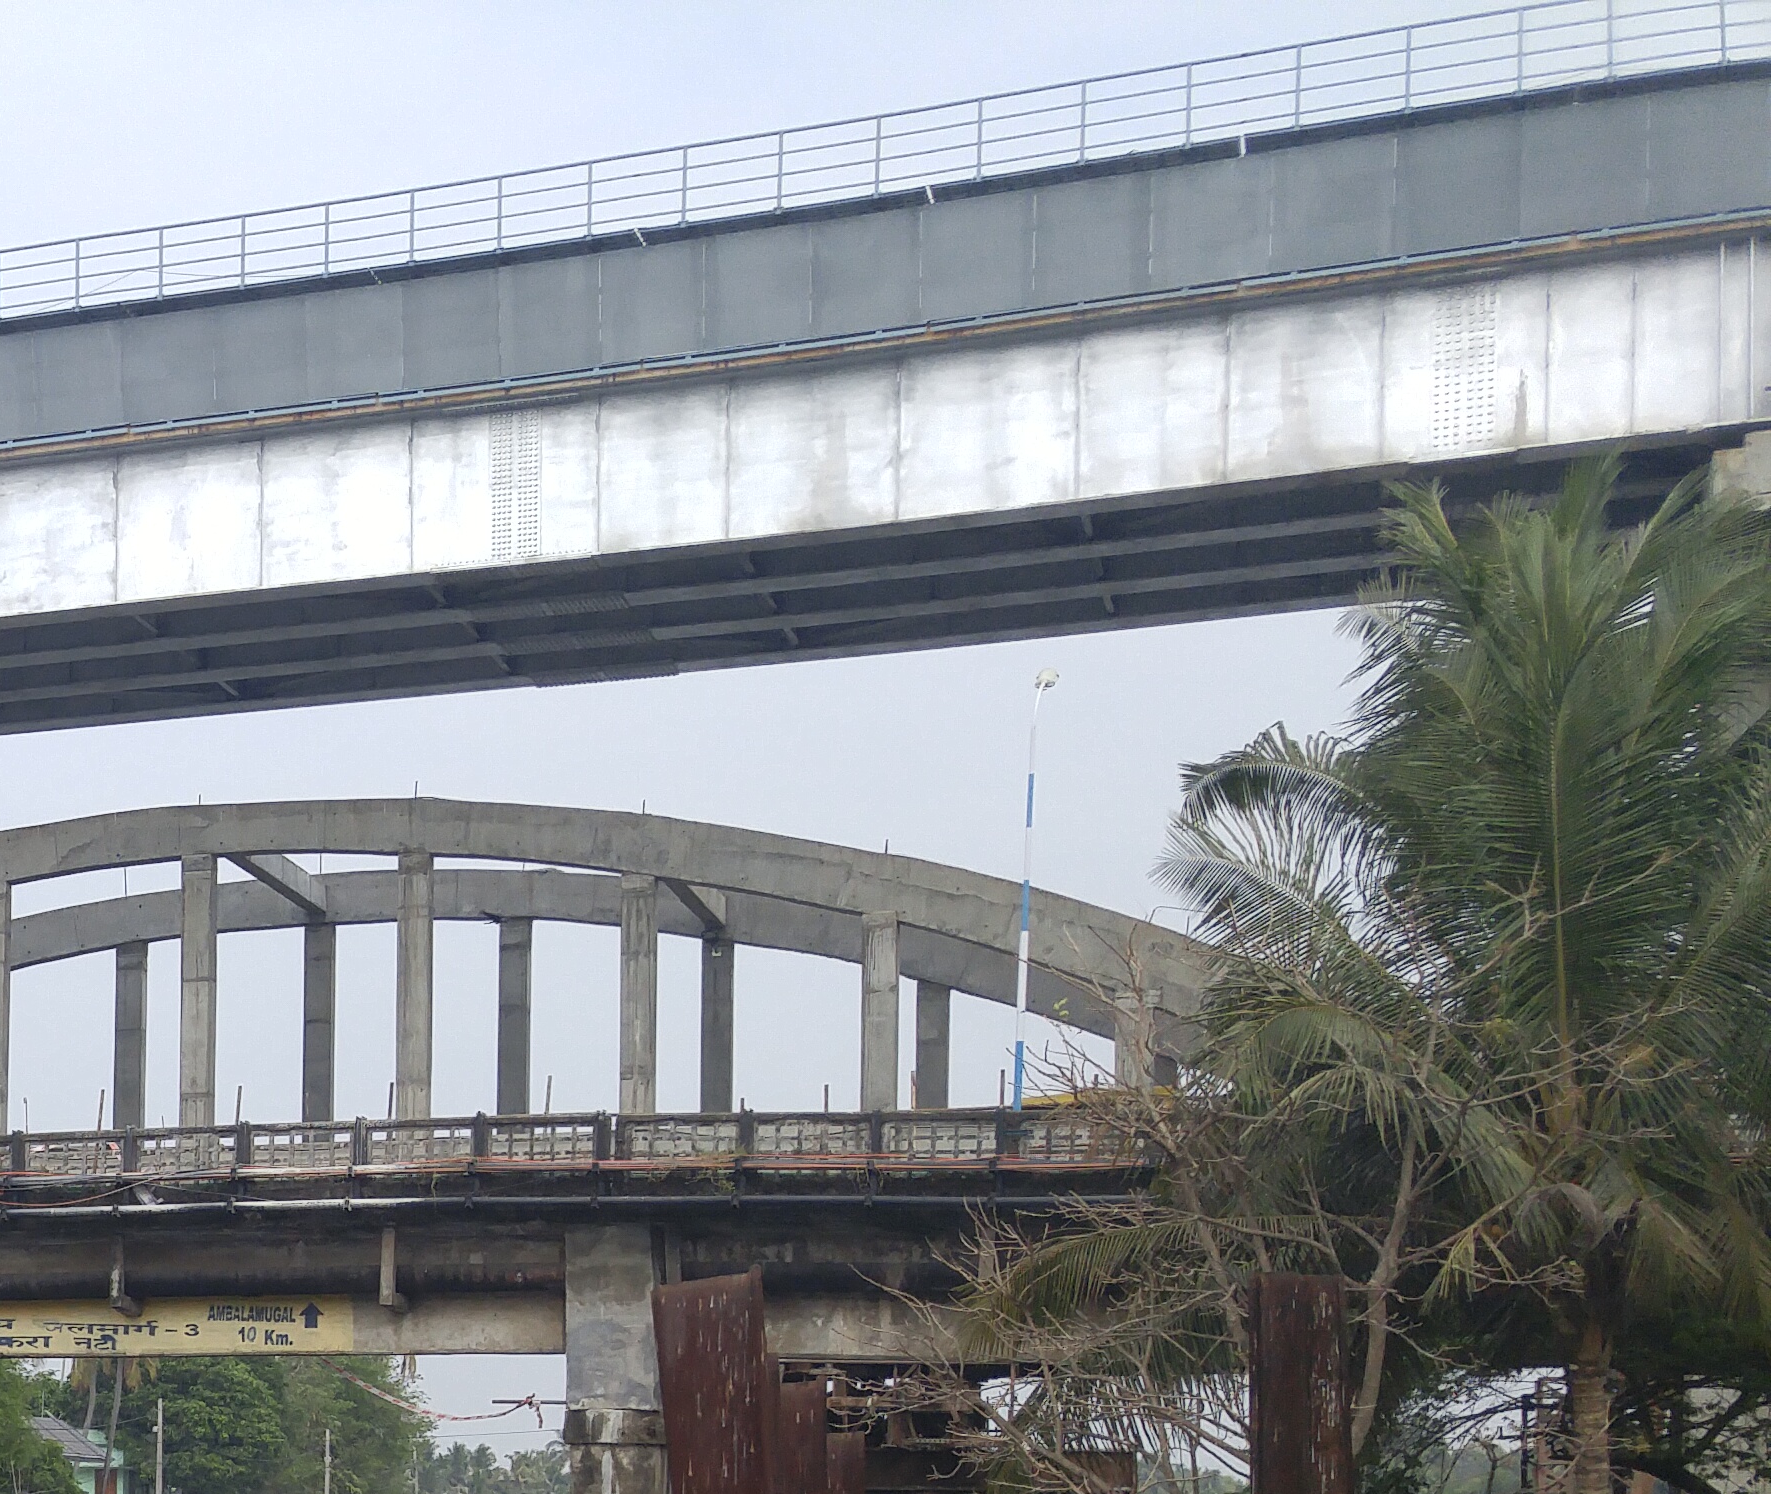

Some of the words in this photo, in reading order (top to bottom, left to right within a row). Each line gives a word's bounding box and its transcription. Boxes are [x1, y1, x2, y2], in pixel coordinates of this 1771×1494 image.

[208, 1304, 296, 1323] AMBALAMUGAL
[43, 1320, 158, 1337] जलमार्ग
[184, 1323, 199, 1337] 3
[238, 1326, 257, 1343] 10
[264, 1329, 293, 1346] Km.
